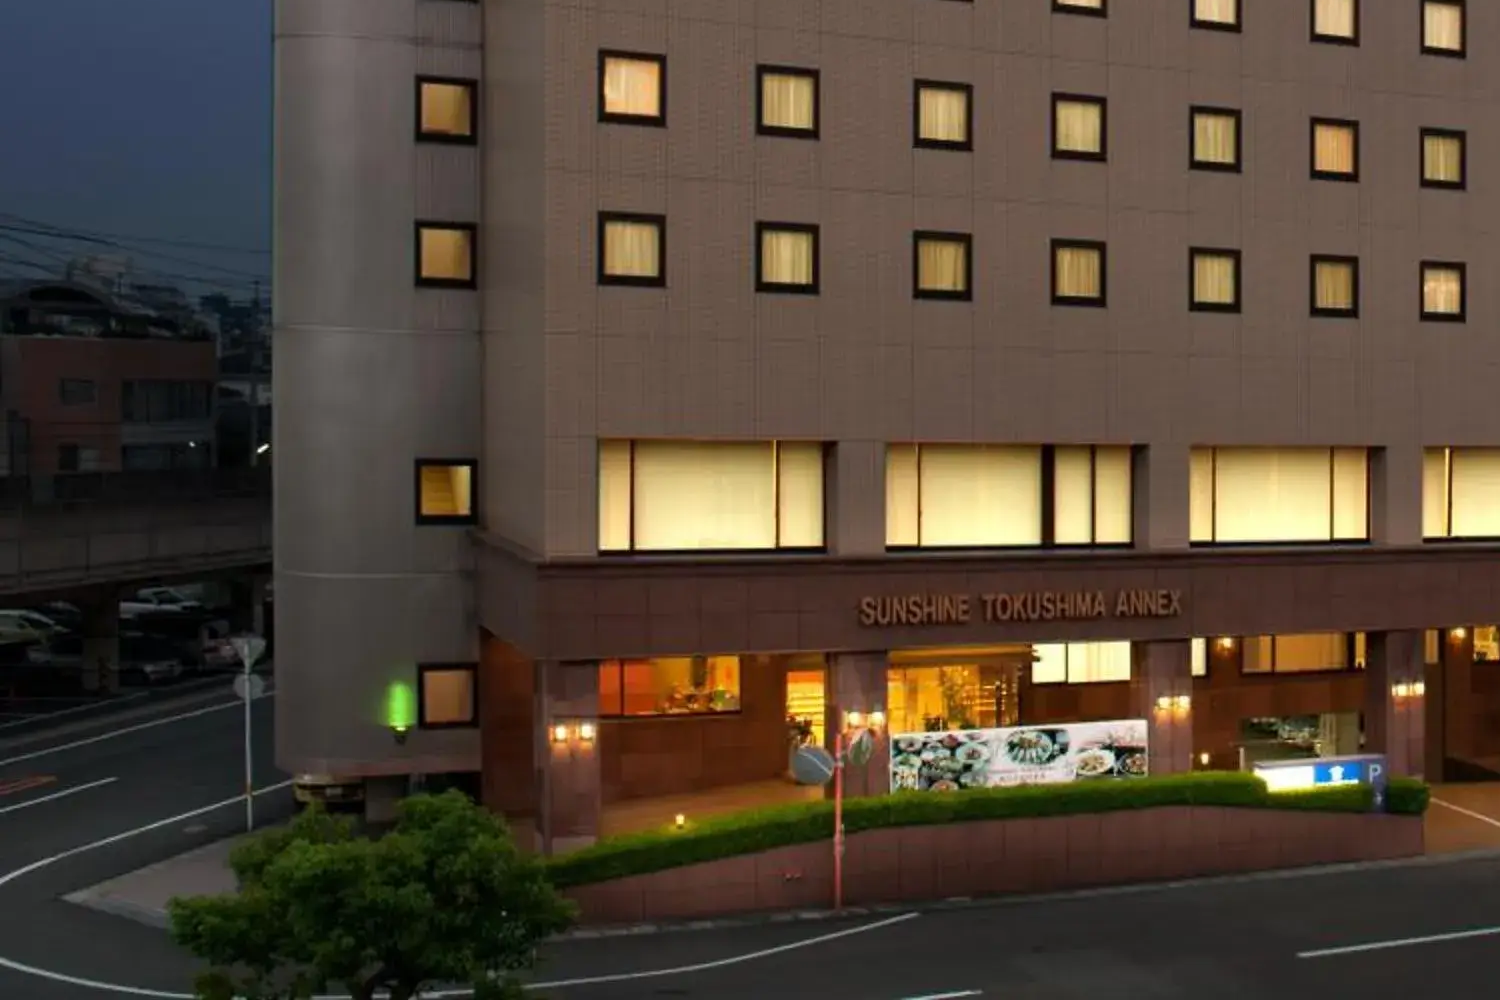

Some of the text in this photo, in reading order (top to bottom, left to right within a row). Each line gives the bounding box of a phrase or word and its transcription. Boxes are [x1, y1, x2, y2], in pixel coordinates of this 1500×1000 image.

[860, 588, 1184, 626] SUNSHINE TOKUSHIMA ANNEX
